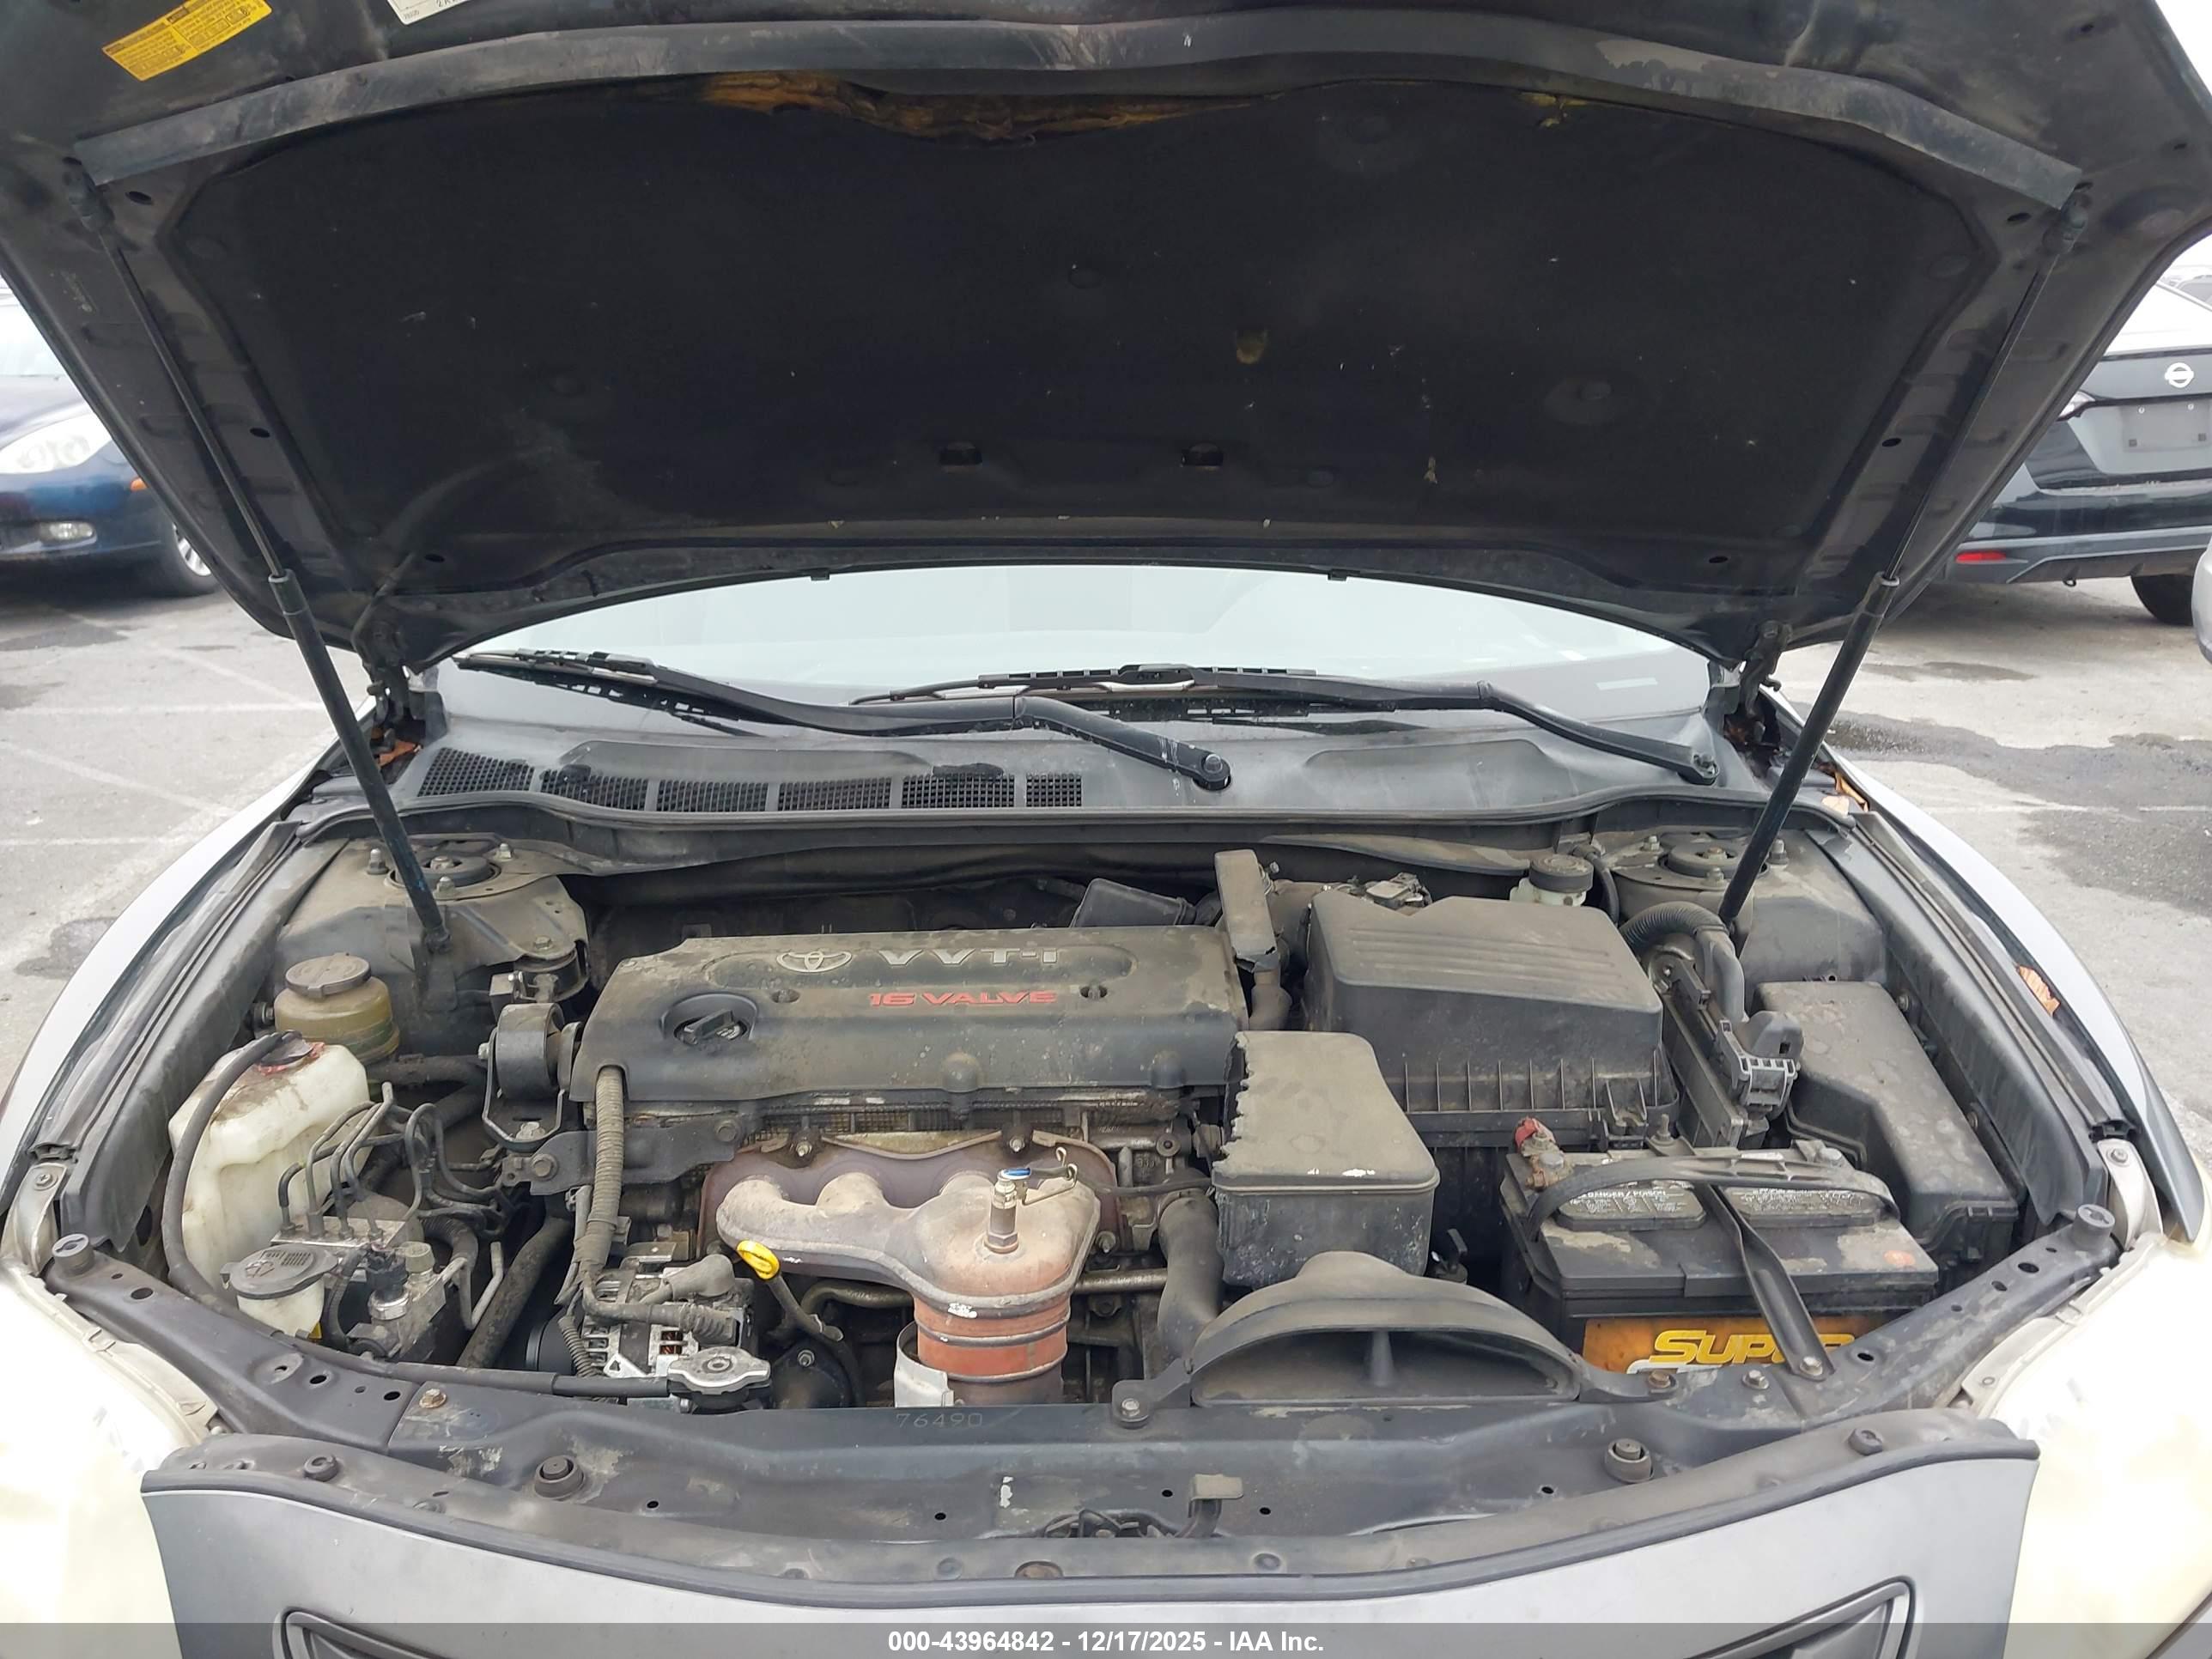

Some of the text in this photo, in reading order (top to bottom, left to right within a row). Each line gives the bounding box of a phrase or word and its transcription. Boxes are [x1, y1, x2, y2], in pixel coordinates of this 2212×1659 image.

[870, 991, 1057, 1006] 16 VALVE
[896, 1413, 983, 1428] 76490
